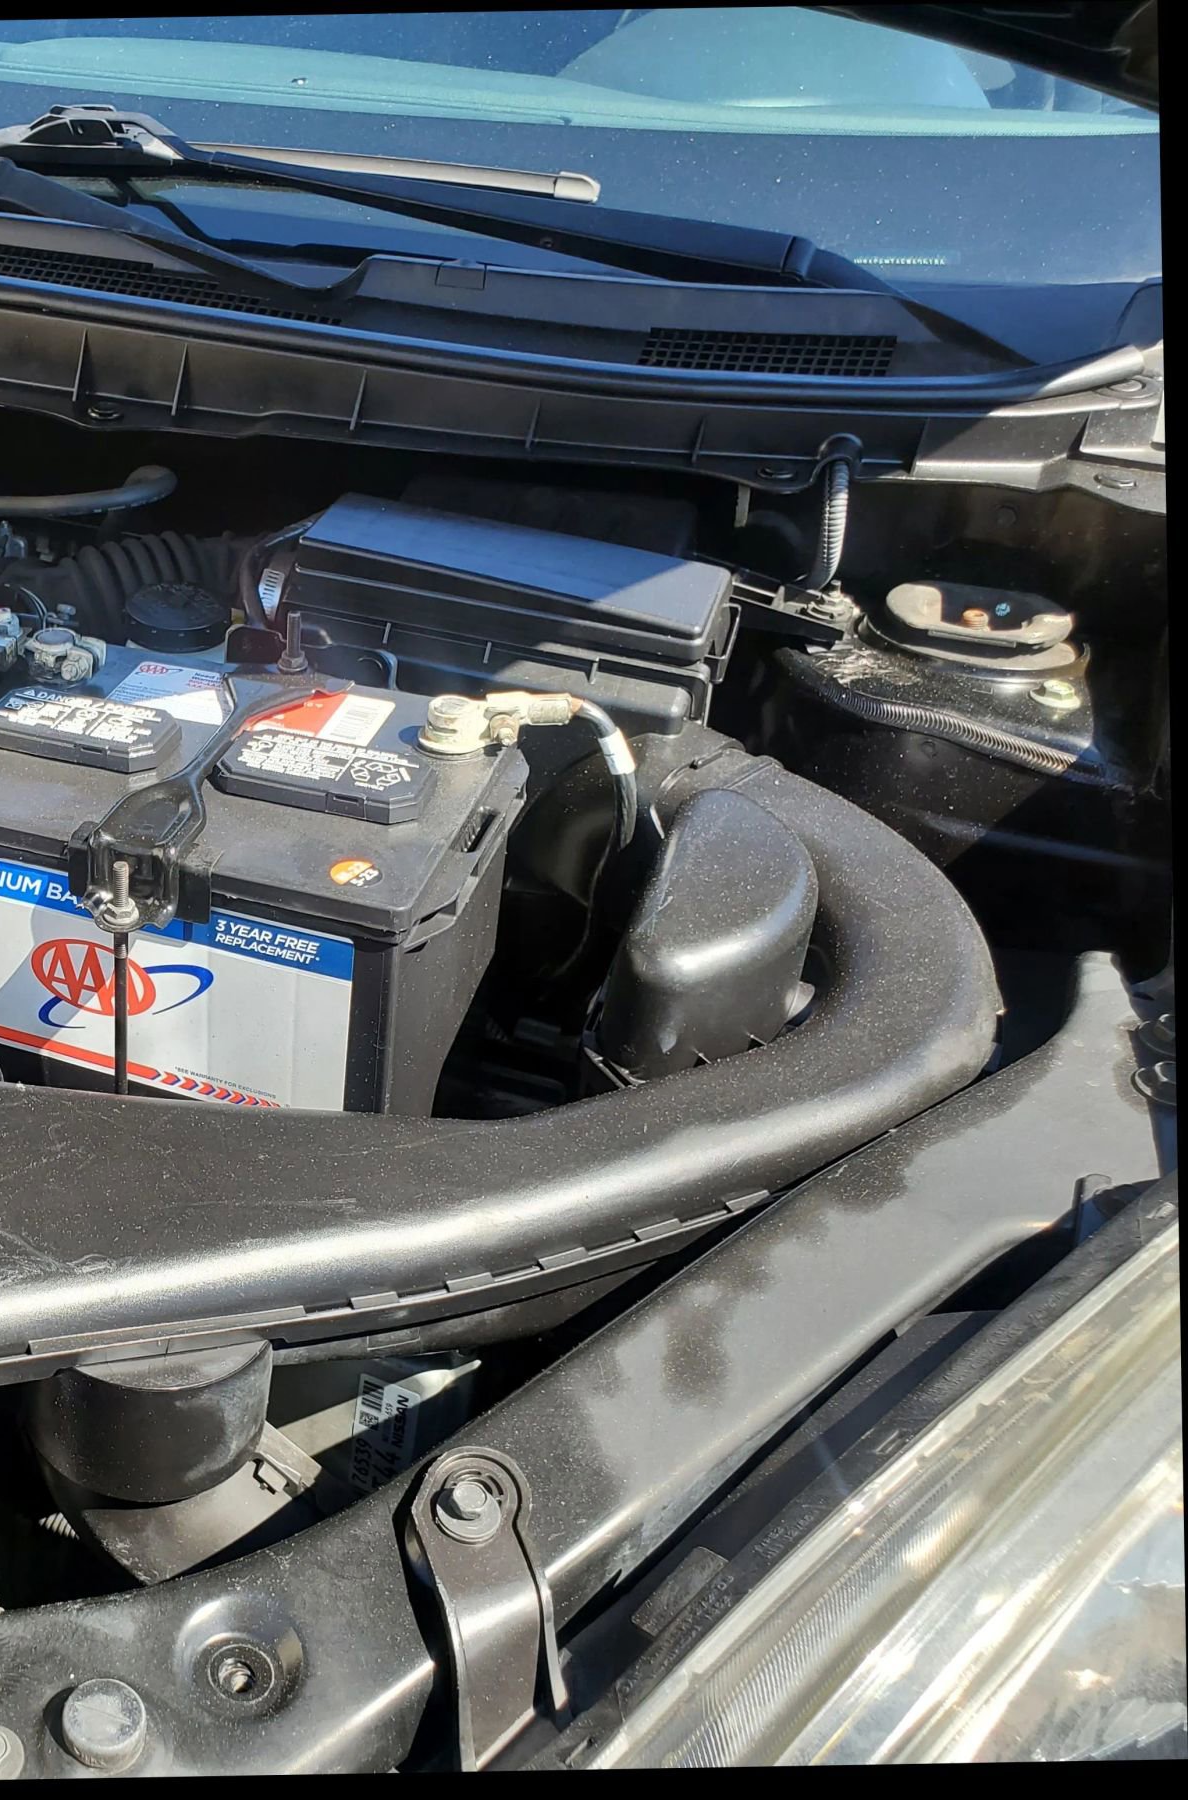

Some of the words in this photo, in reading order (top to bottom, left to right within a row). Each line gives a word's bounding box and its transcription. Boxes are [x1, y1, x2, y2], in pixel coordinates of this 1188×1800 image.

[215, 920, 227, 932] 3
[230, 922, 273, 943] YEAR
[274, 934, 320, 954] FREE
[33, 939, 155, 1016] AAA
[190, 1070, 223, 1084] WARRANTY
[224, 1080, 237, 1089] FOR
[238, 1084, 277, 1099] EXCLUSIONS
[391, 1395, 410, 1448] NISSAN
